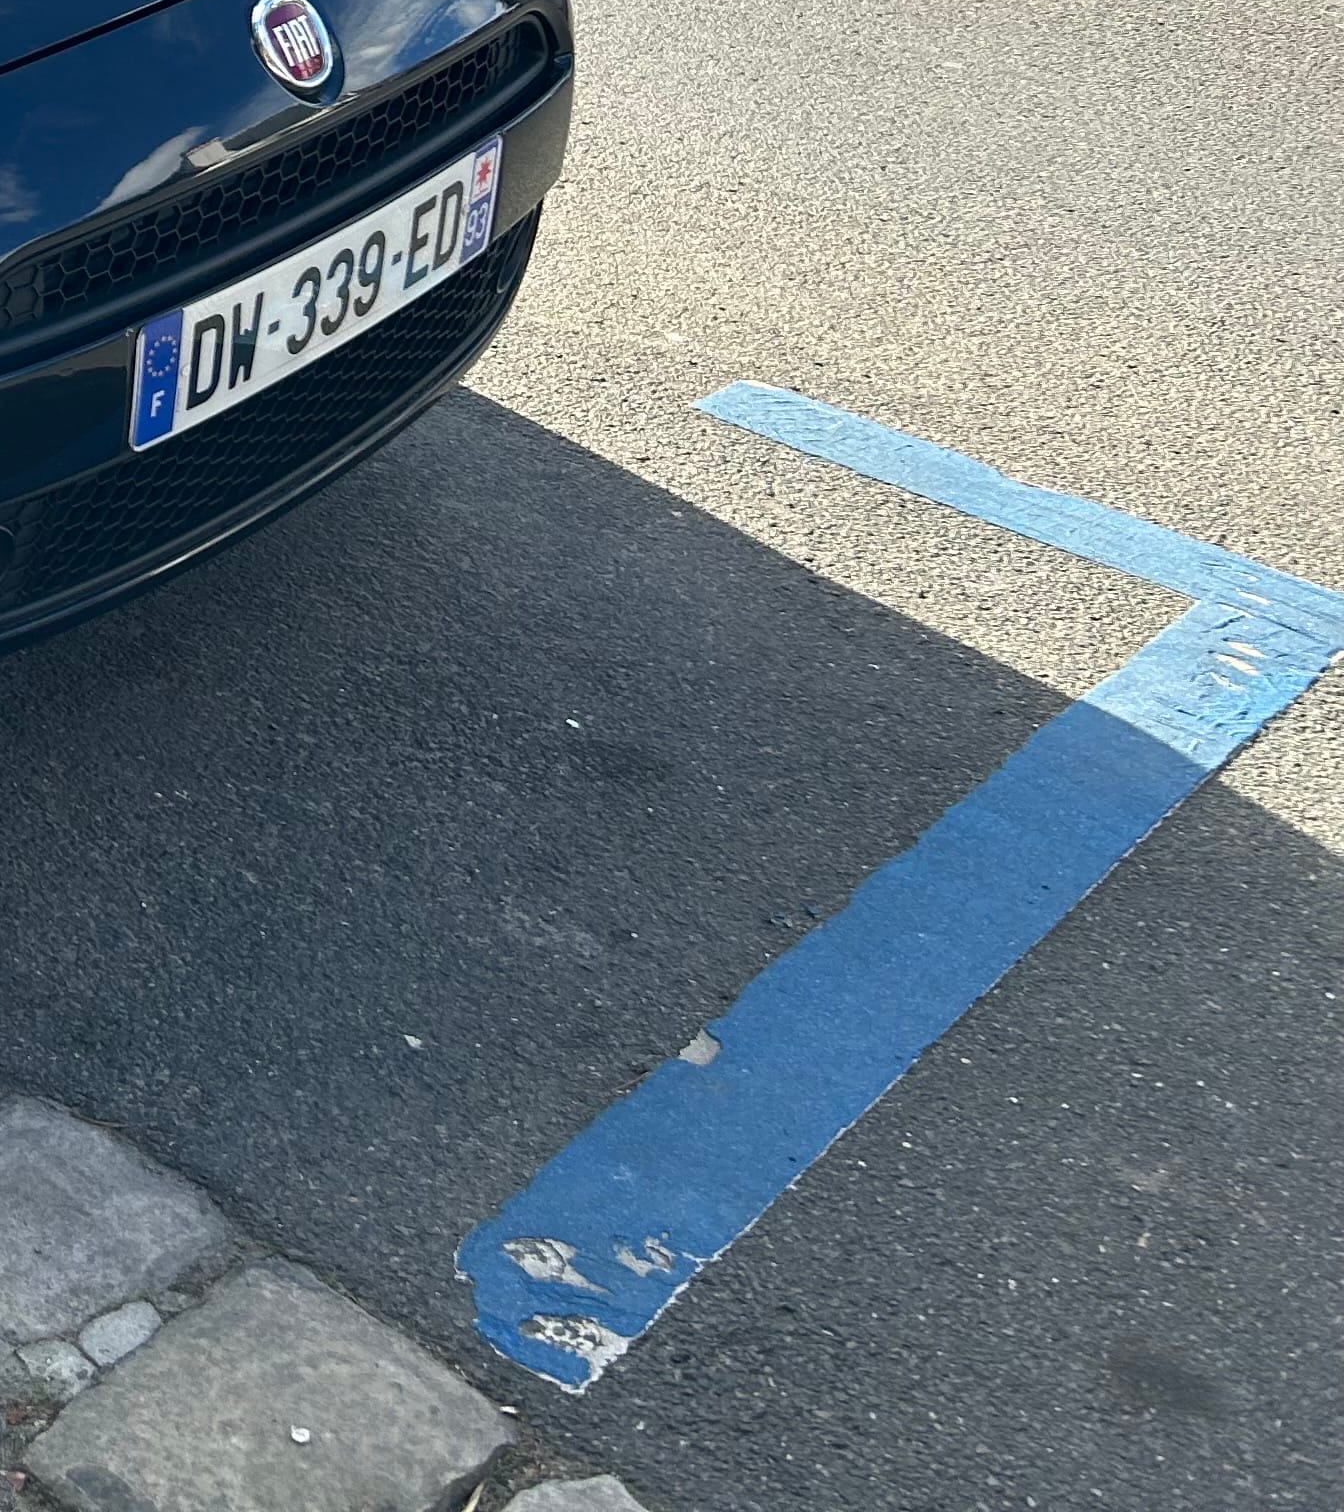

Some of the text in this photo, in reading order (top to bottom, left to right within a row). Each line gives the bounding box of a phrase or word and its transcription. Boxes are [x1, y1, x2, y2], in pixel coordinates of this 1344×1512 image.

[272, 14, 320, 67] FIAT
[464, 201, 489, 247] 93
[186, 180, 464, 411] DW-339-ED
[150, 390, 165, 418] F
